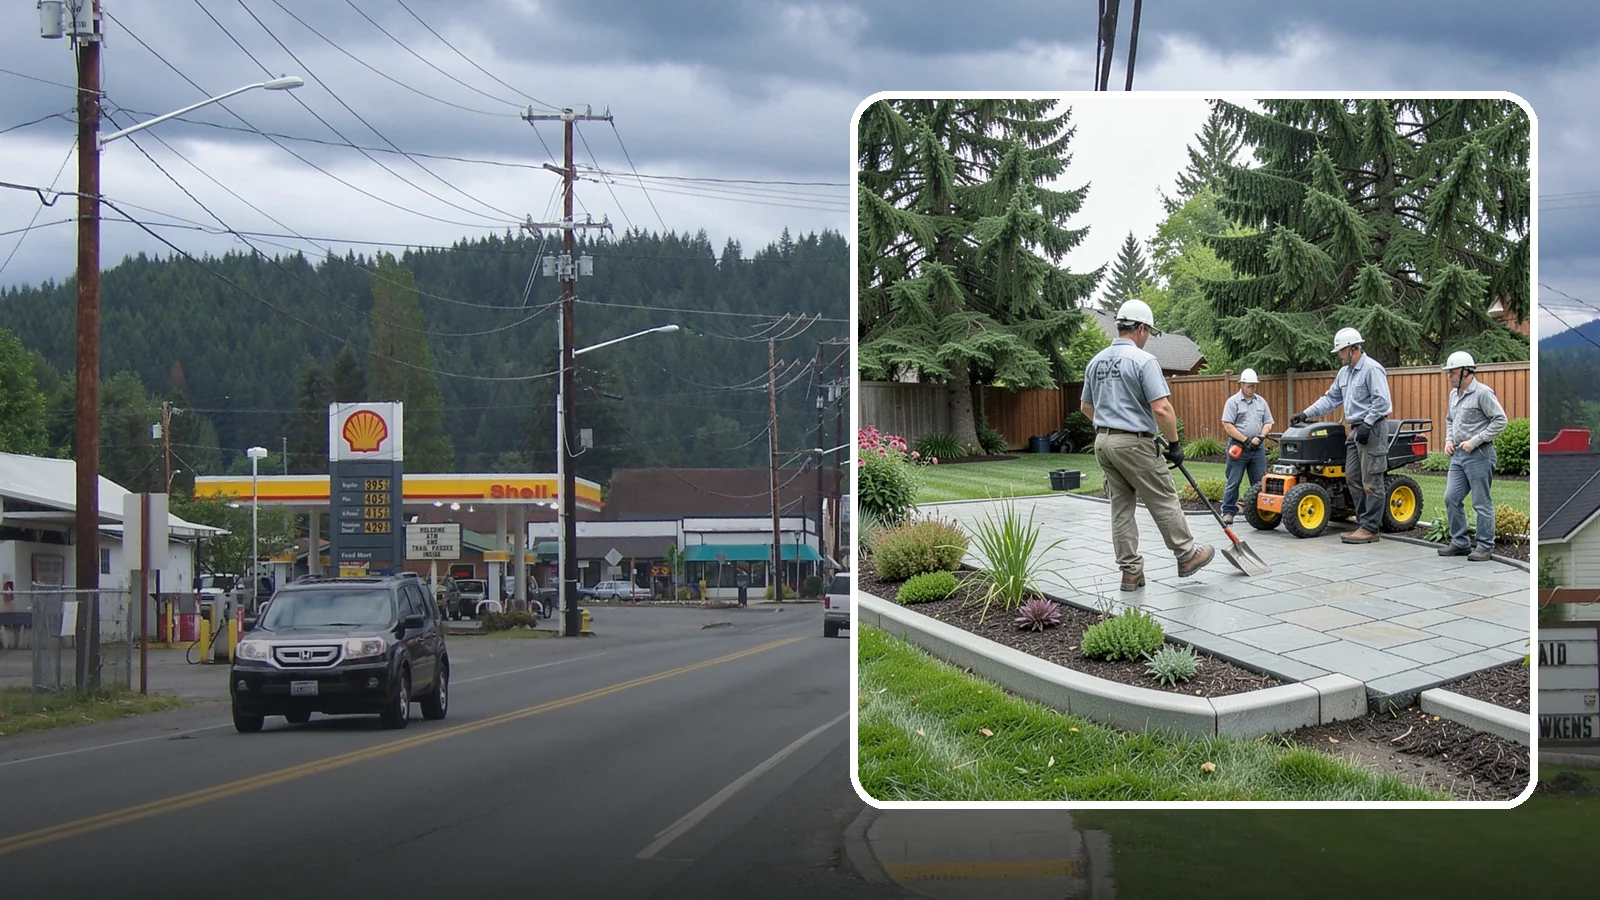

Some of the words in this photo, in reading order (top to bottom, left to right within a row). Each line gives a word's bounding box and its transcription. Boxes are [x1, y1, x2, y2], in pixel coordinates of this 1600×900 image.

[366, 480, 383, 490] 395
[490, 484, 547, 499] Shell
[366, 494, 383, 504] 405
[366, 508, 383, 518] 415
[366, 522, 383, 532] 429
